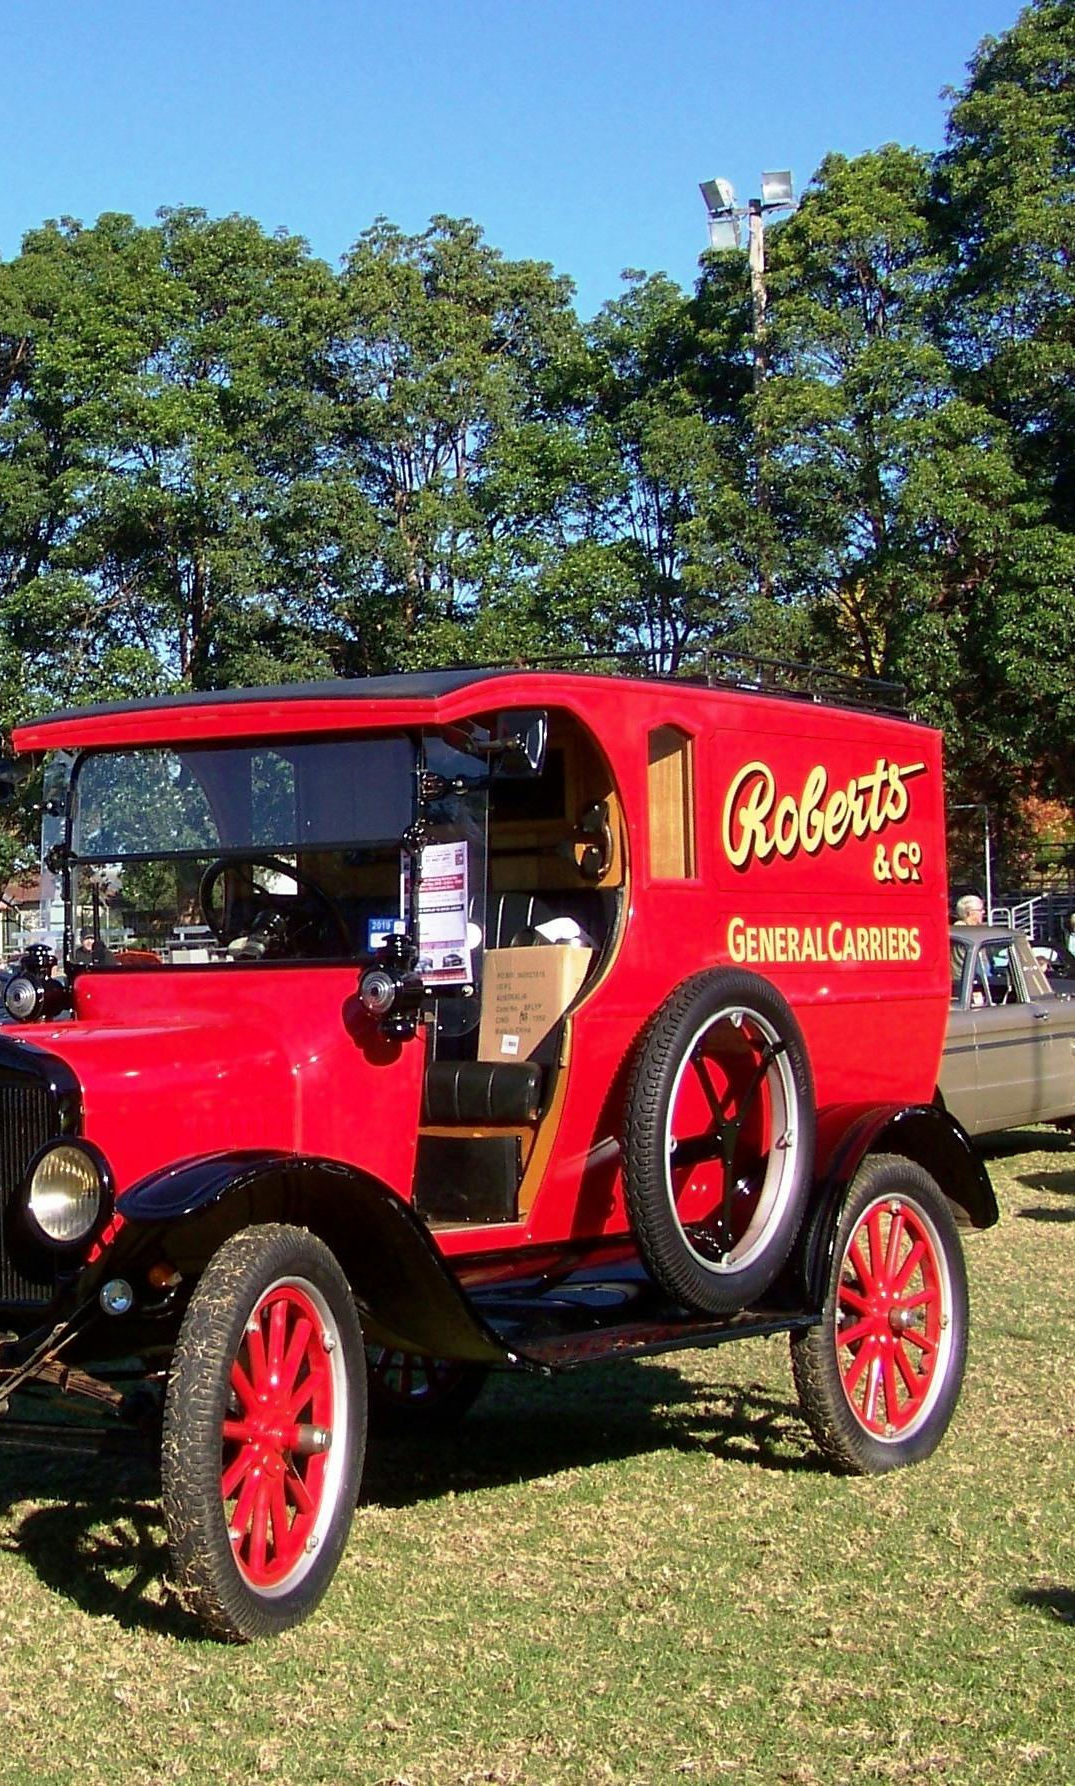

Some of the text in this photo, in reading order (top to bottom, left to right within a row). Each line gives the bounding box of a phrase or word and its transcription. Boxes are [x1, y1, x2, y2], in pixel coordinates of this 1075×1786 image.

[723, 759, 925, 867] Roberts
[728, 917, 921, 963] GENERAL CARRIERS
